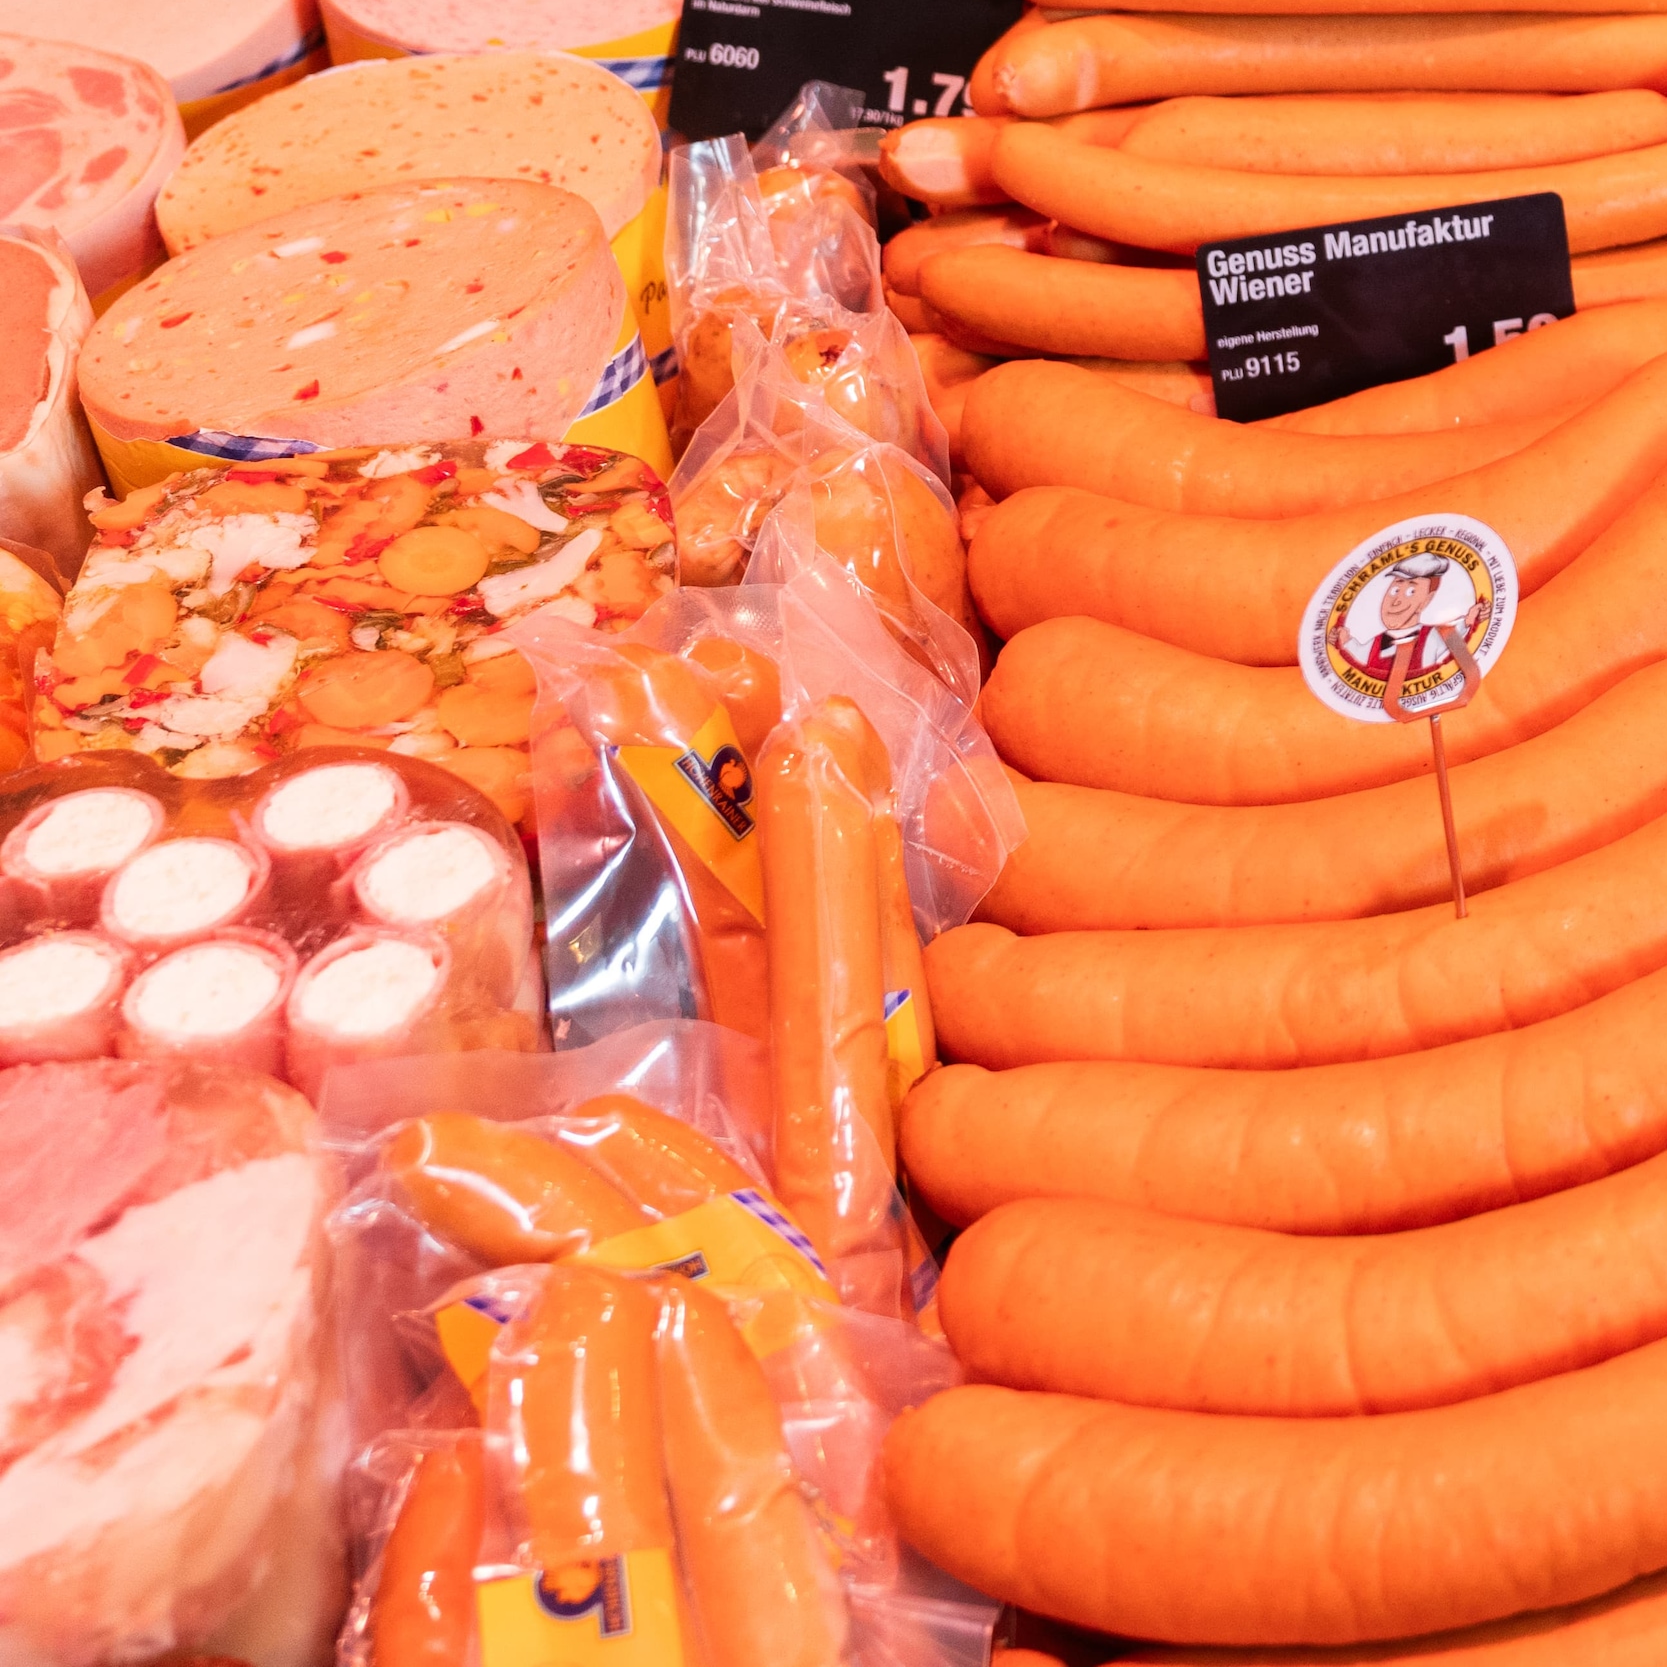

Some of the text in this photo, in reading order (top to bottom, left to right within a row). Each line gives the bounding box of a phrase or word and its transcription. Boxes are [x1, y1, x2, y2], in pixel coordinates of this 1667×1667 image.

[684, 42, 760, 70] PLU 6060
[883, 66, 978, 117] 1.7
[1207, 213, 1495, 279] Genuss Manufaktur
[1209, 269, 1315, 306] Wiener
[1216, 324, 1319, 349] eigene Herstellung
[1221, 351, 1301, 382] PLU 9115
[1425, 539, 1479, 571] GENUSS
[1342, 666, 1444, 695] MANUKTUR
